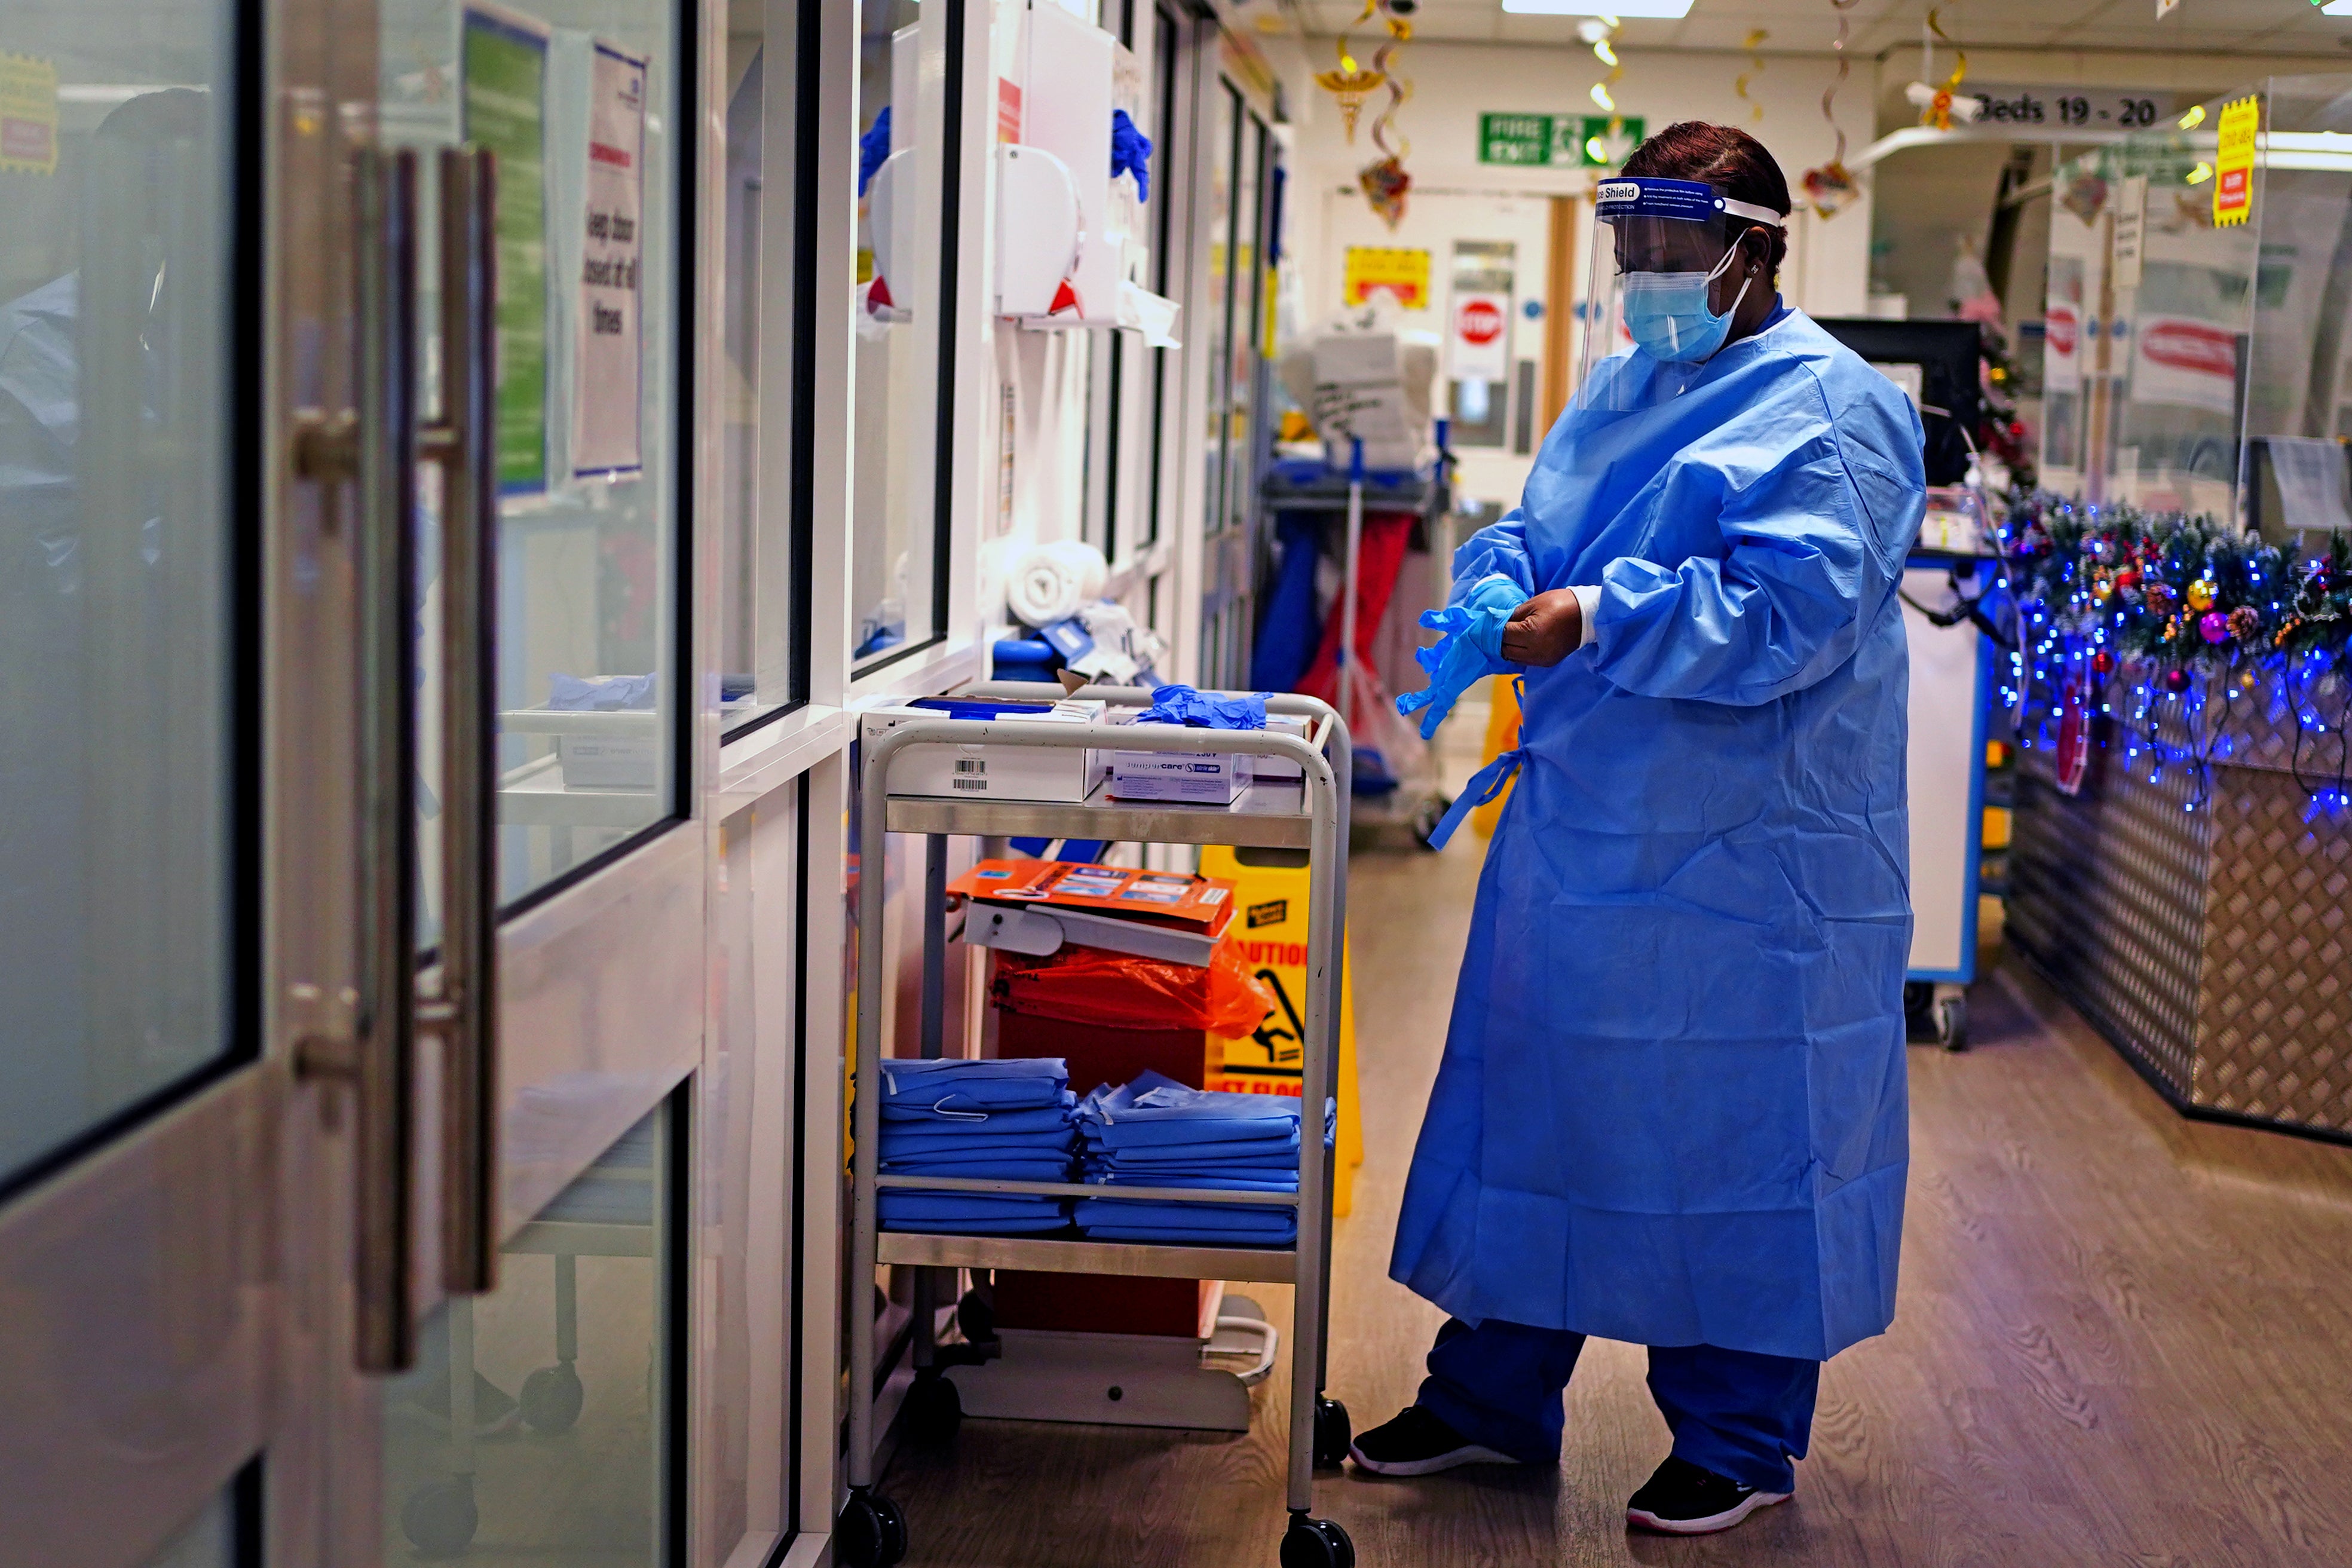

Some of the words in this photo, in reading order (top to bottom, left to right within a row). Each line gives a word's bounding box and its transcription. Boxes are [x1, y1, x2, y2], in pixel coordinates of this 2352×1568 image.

[2057, 96, 2090, 125] 19
[2118, 98, 2158, 127] 20
[1606, 187, 1634, 198] Shield
